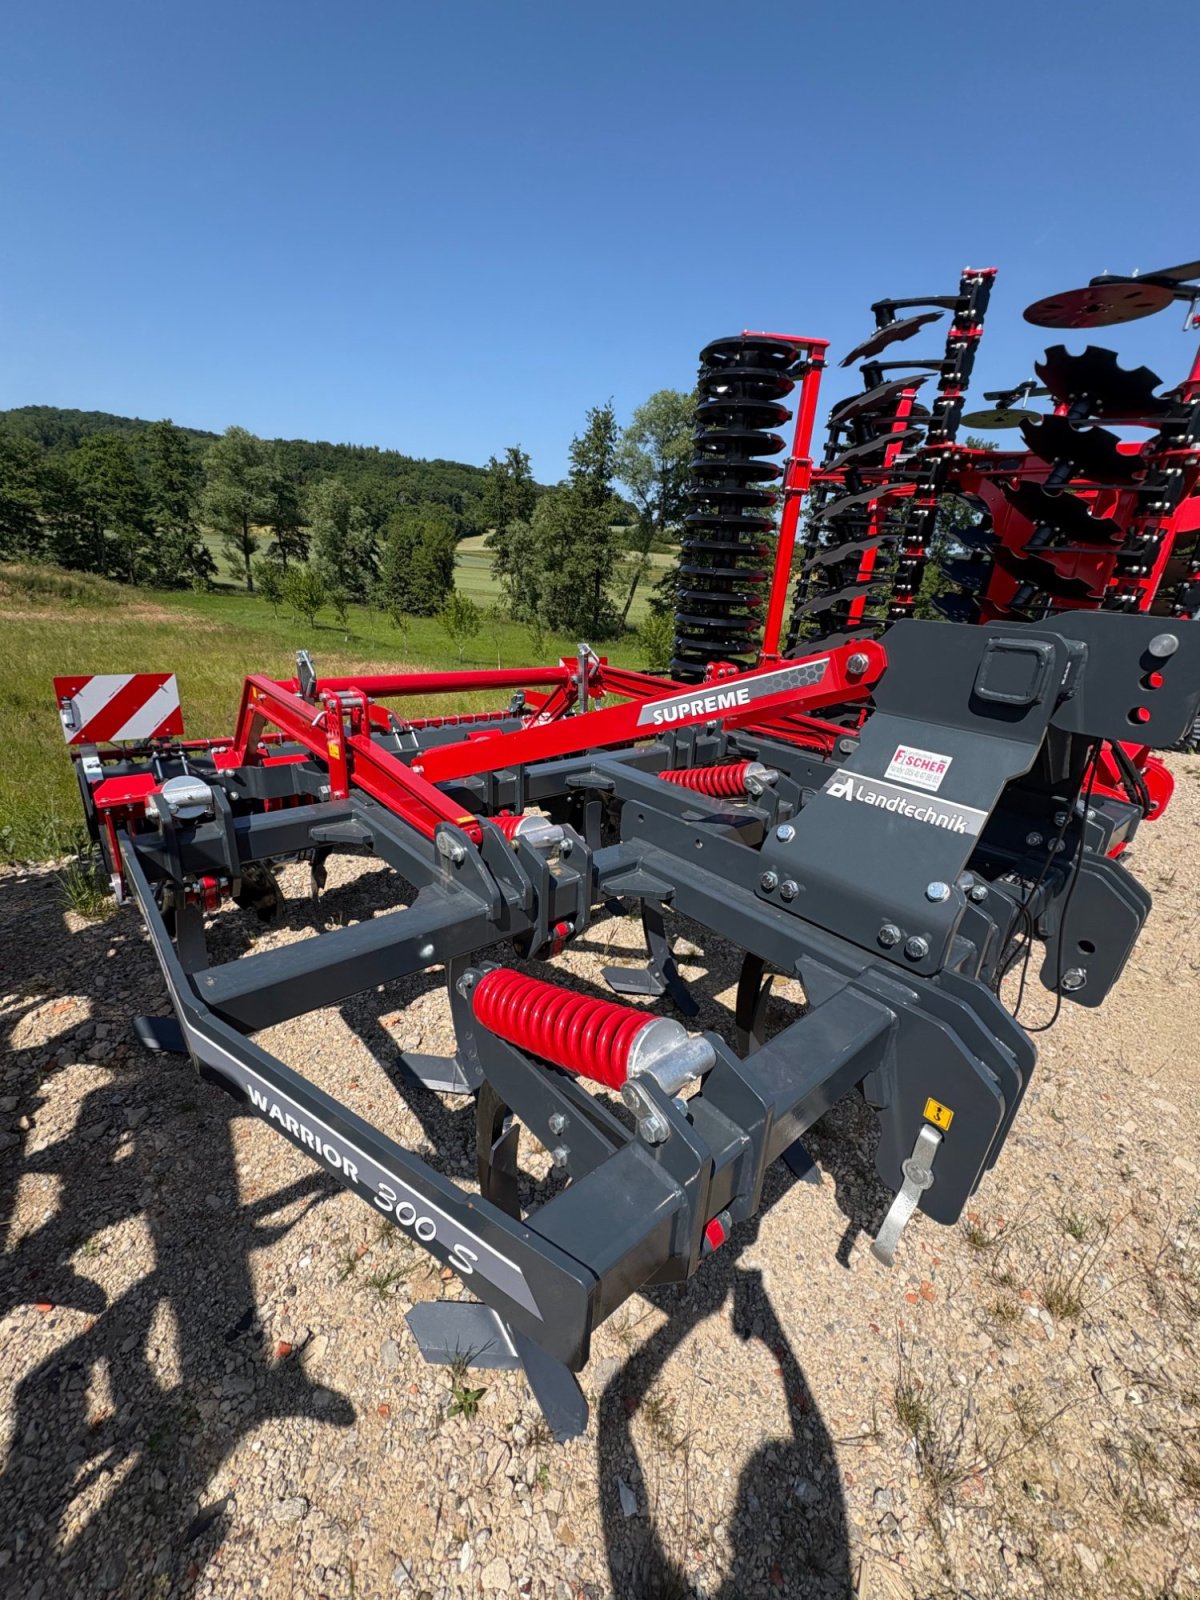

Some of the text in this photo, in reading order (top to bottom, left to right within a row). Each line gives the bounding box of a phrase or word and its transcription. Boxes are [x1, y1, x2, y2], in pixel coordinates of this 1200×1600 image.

[653, 688, 750, 725] SUPREME
[894, 749, 946, 774] FISCHER
[855, 785, 969, 834] Landtechnik
[246, 1083, 479, 1275] WARRIOR 300 S
